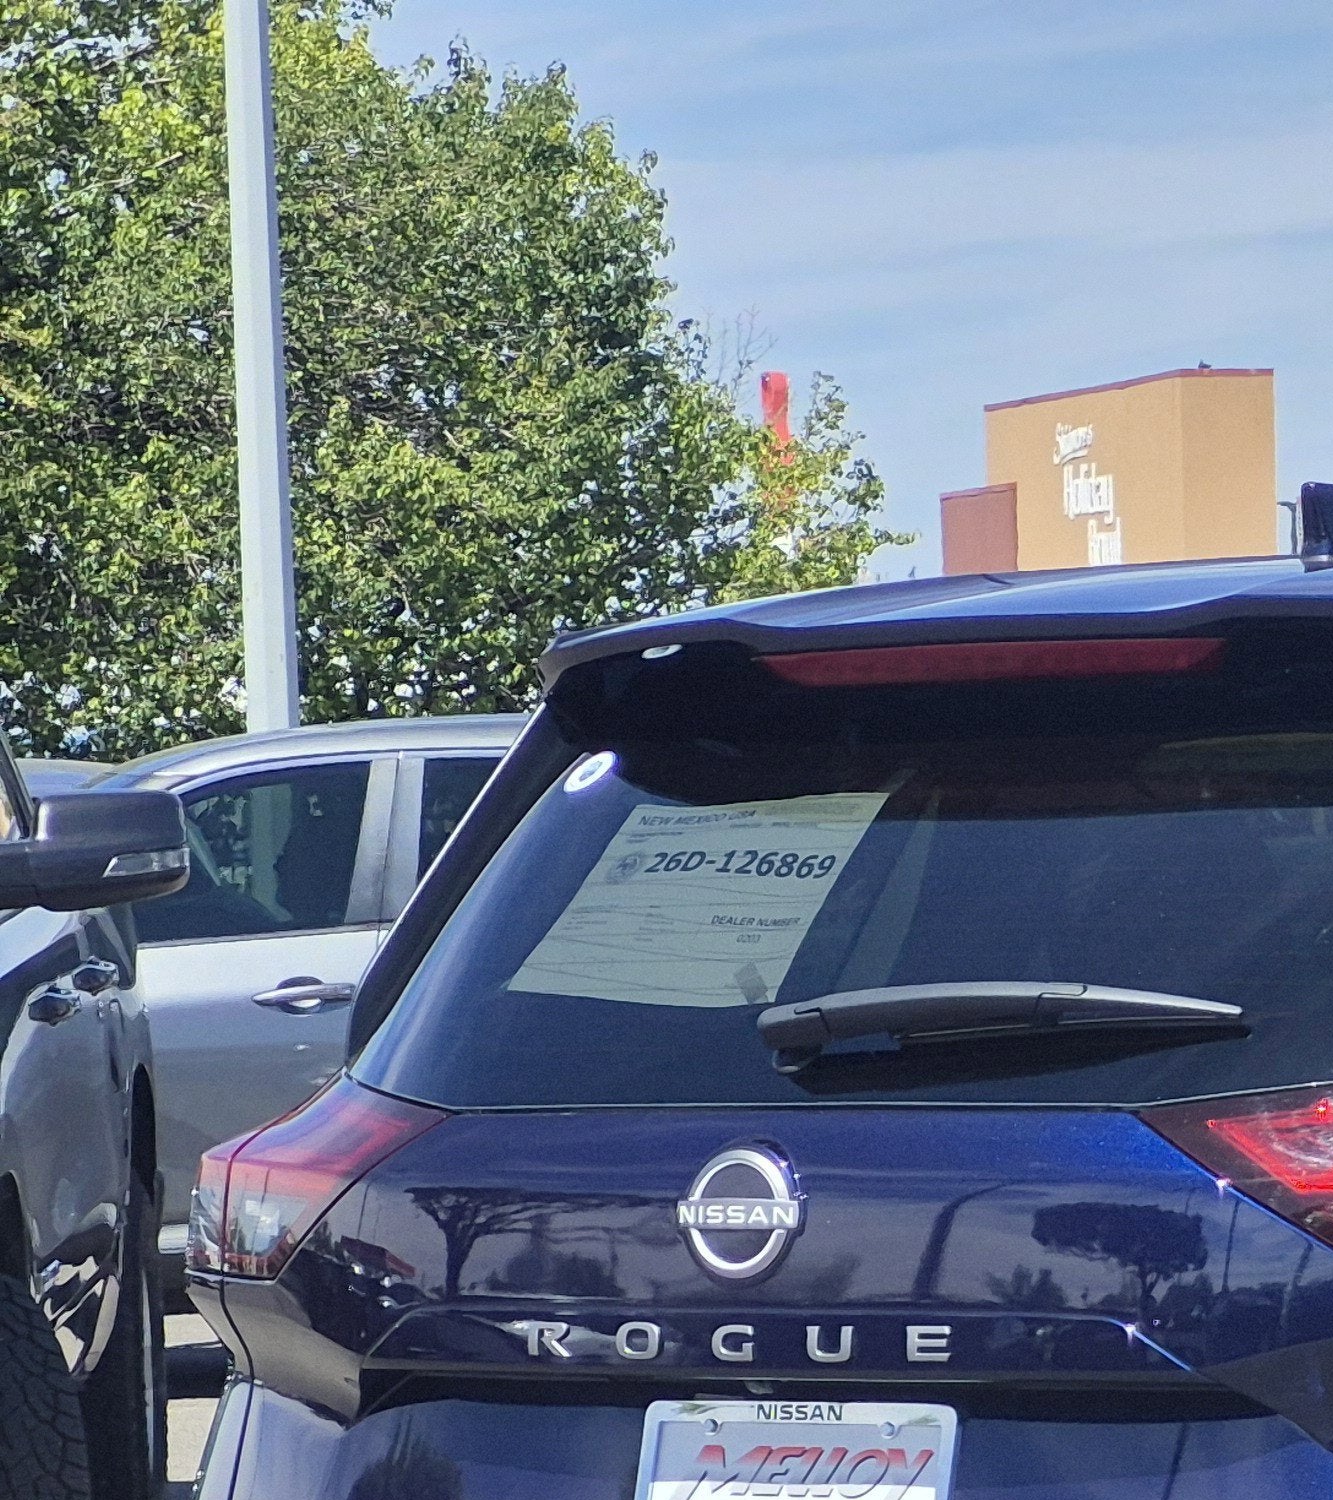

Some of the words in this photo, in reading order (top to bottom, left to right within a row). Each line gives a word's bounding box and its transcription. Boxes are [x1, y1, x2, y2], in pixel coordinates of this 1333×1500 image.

[637, 814, 671, 827] NEW
[643, 850, 837, 880] 26D-126869
[711, 914, 755, 926] DEALER
[756, 916, 802, 927] NUMBER
[678, 1203, 796, 1226] NISSAN
[526, 1320, 953, 1363] ROGUE
[755, 1403, 844, 1422] NISSAN
